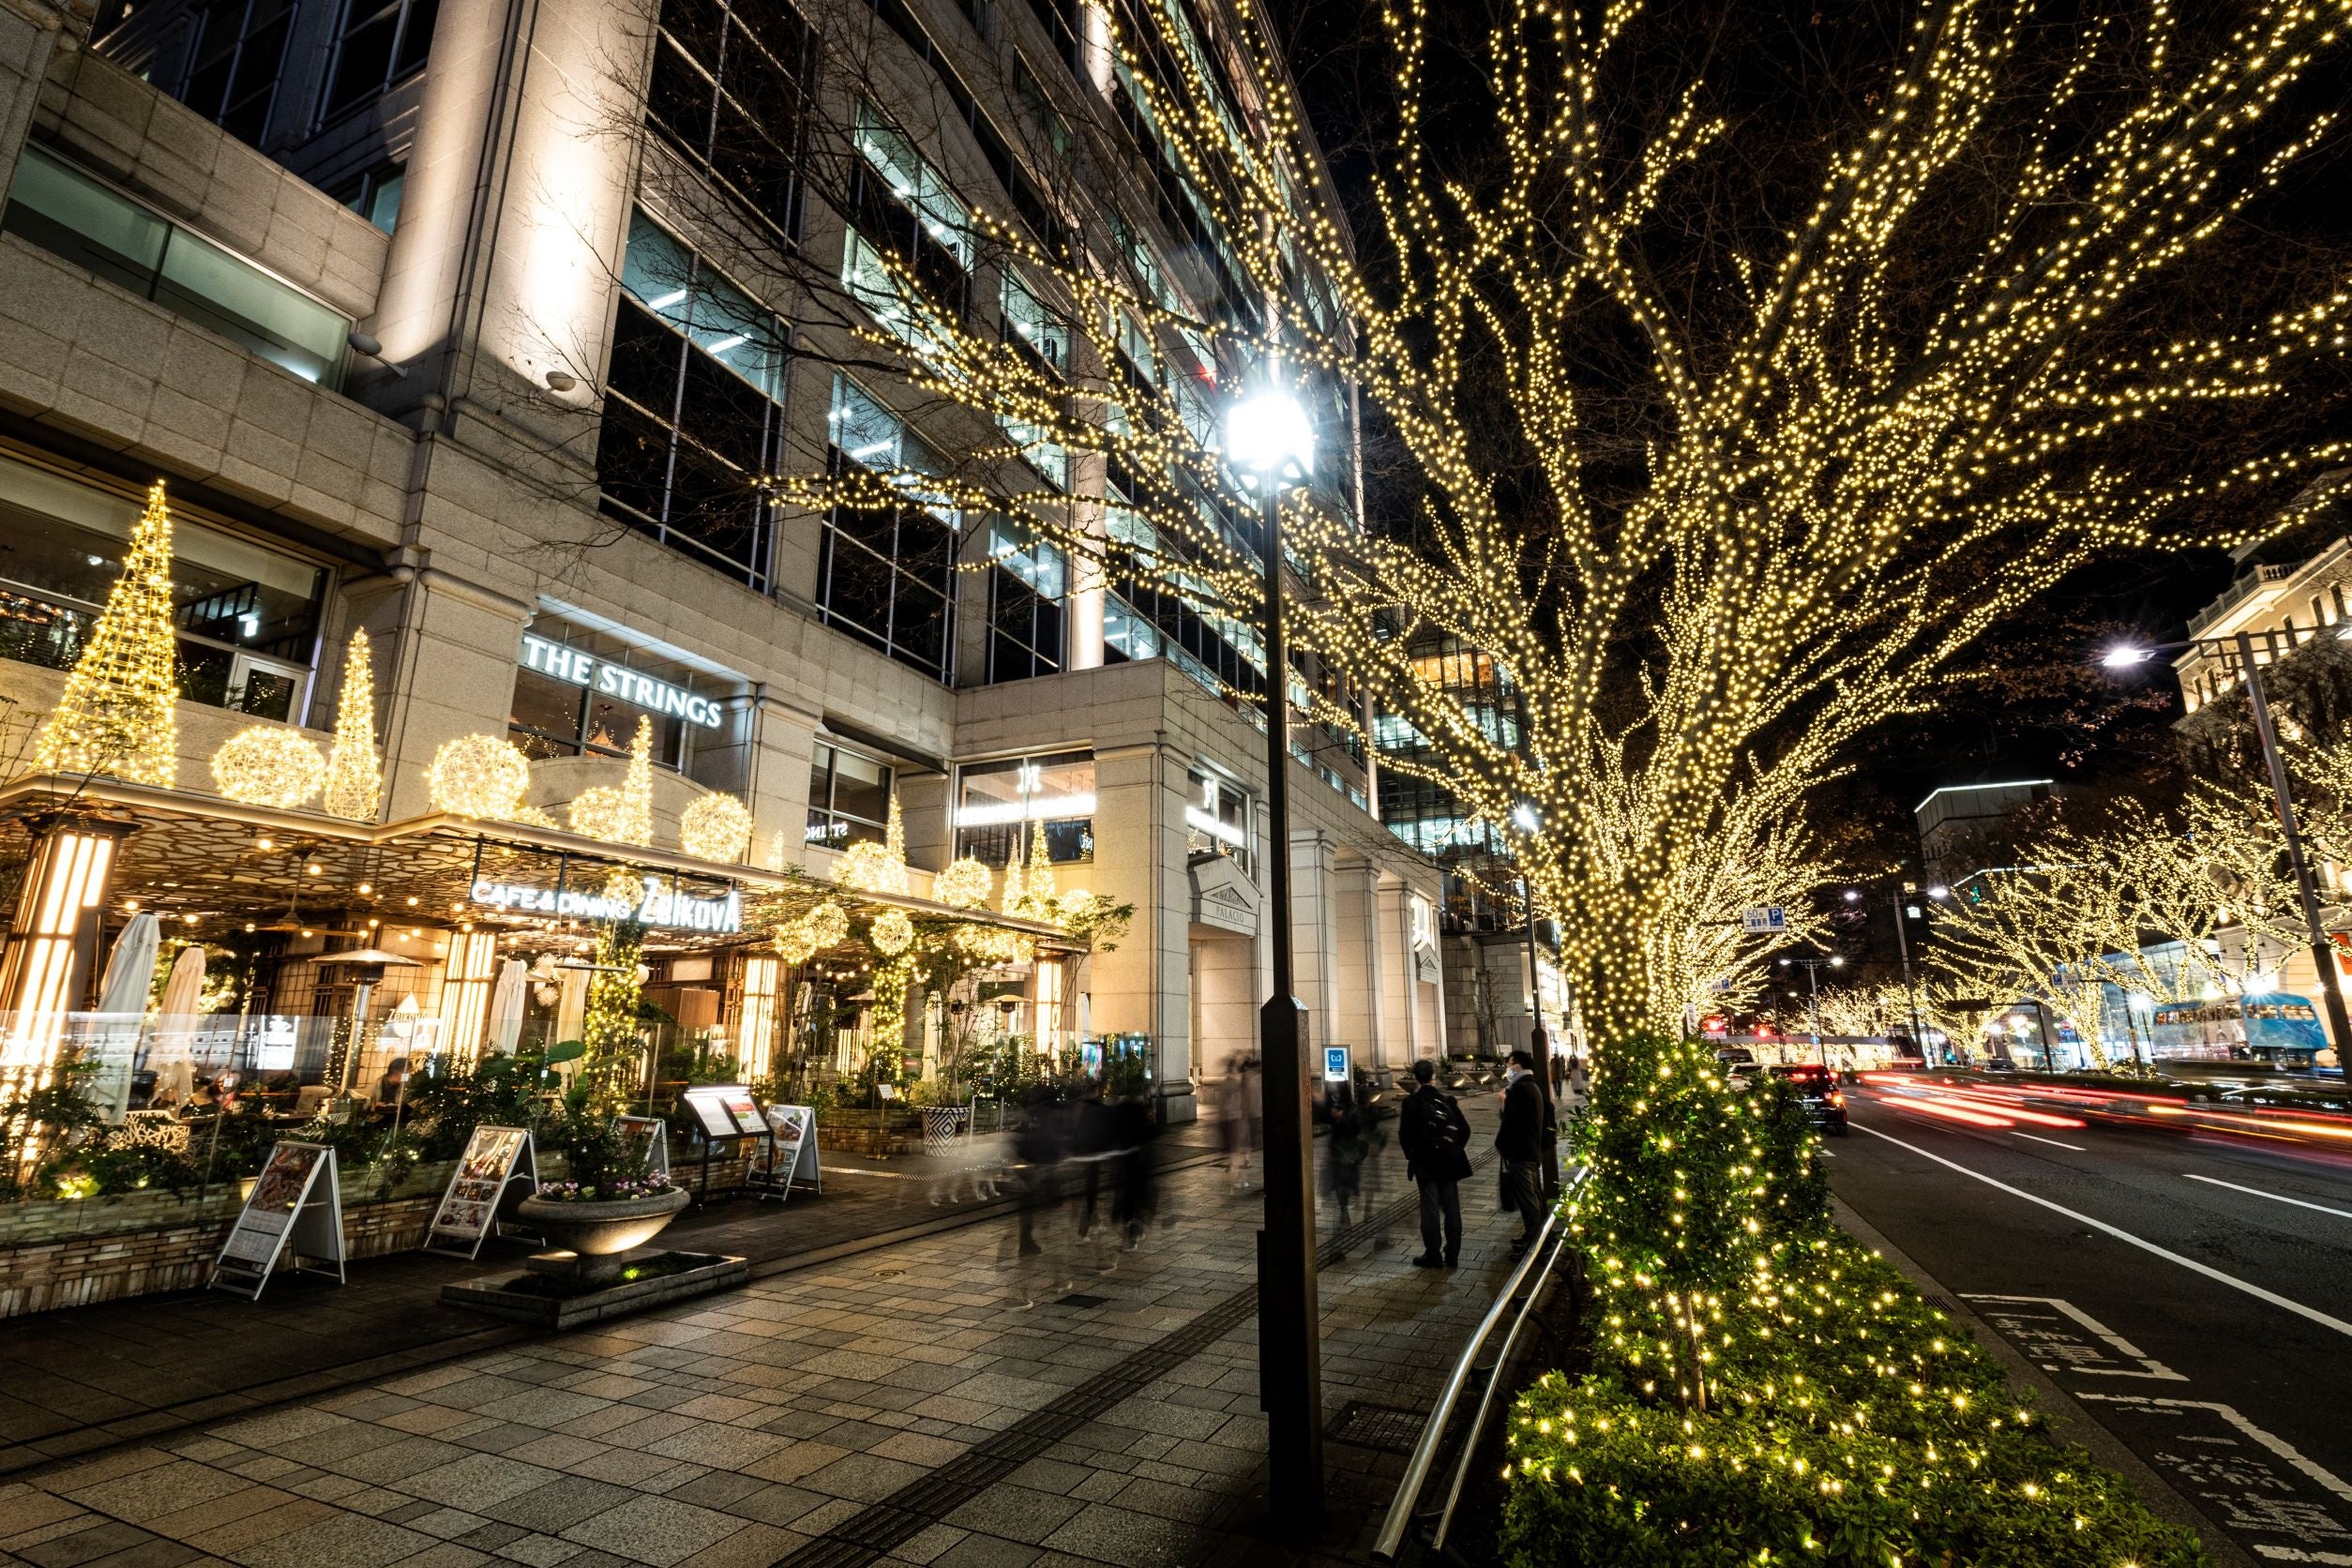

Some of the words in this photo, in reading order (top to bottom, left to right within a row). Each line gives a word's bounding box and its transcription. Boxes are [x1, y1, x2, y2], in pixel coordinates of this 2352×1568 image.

[523, 636, 593, 685] THE
[598, 664, 722, 728] STRINGS
[1216, 905, 1244, 924] PALACIO
[1772, 910, 1780, 920] P
